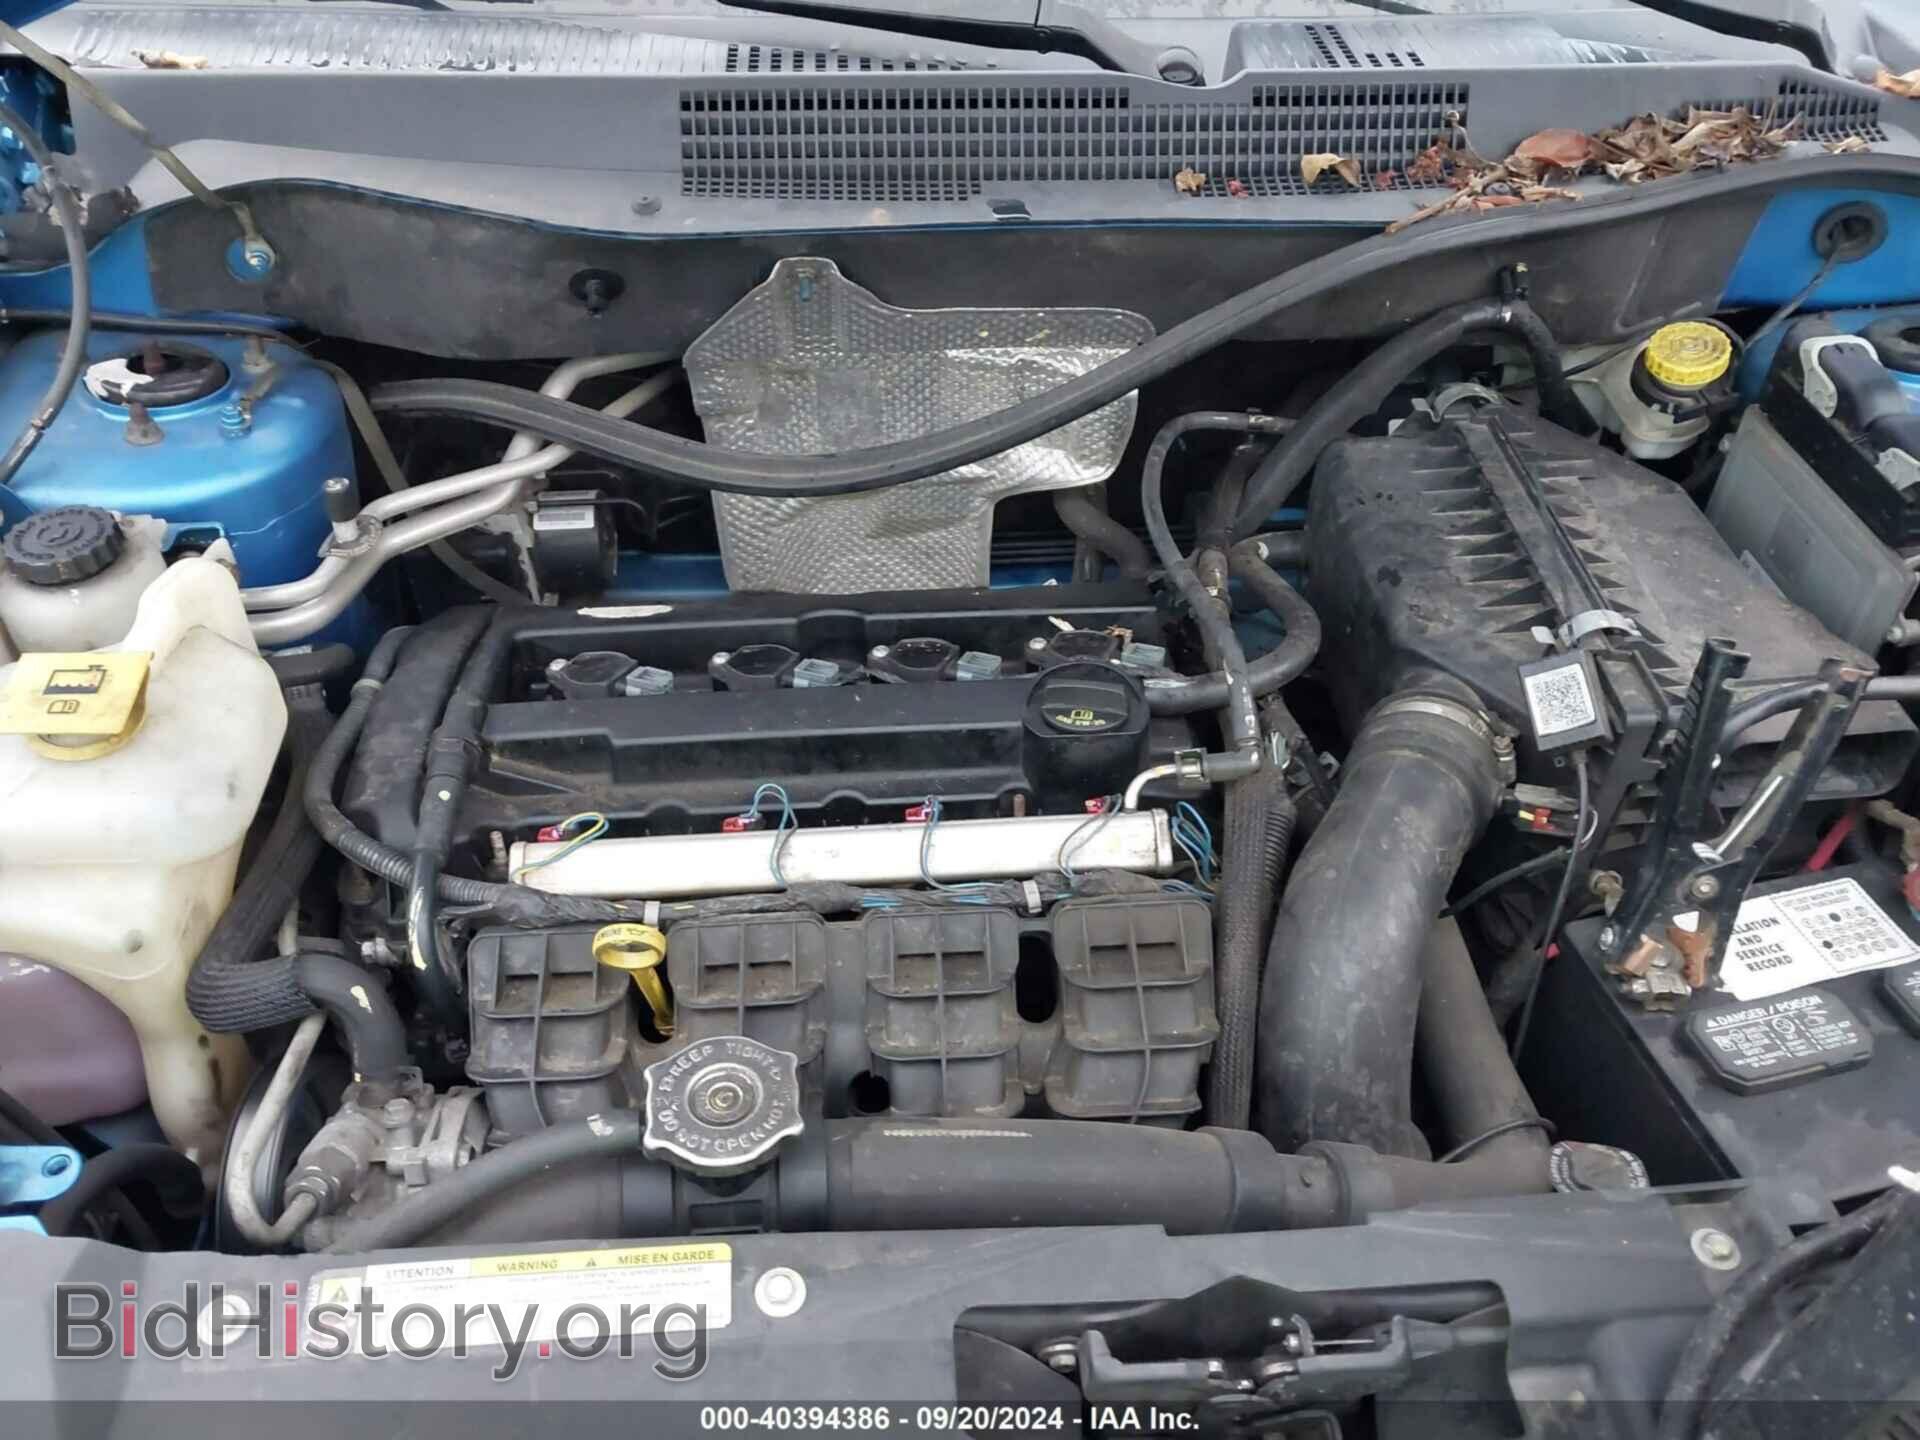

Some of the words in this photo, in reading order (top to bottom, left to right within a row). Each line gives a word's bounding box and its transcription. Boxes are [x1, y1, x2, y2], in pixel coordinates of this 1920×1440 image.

[1731, 917, 1781, 935] LLATION
[1737, 934, 1762, 946] AND
[1735, 943, 1784, 961] SERVICE
[1746, 955, 1793, 972] RECORD
[1716, 1007, 1768, 1025] DANGER
[1776, 995, 1824, 1012] POISON
[497, 1259, 559, 1273] WARNING
[617, 1253, 649, 1265] MISE
[652, 1251, 668, 1263] EN
[671, 1250, 715, 1262] GARDE
